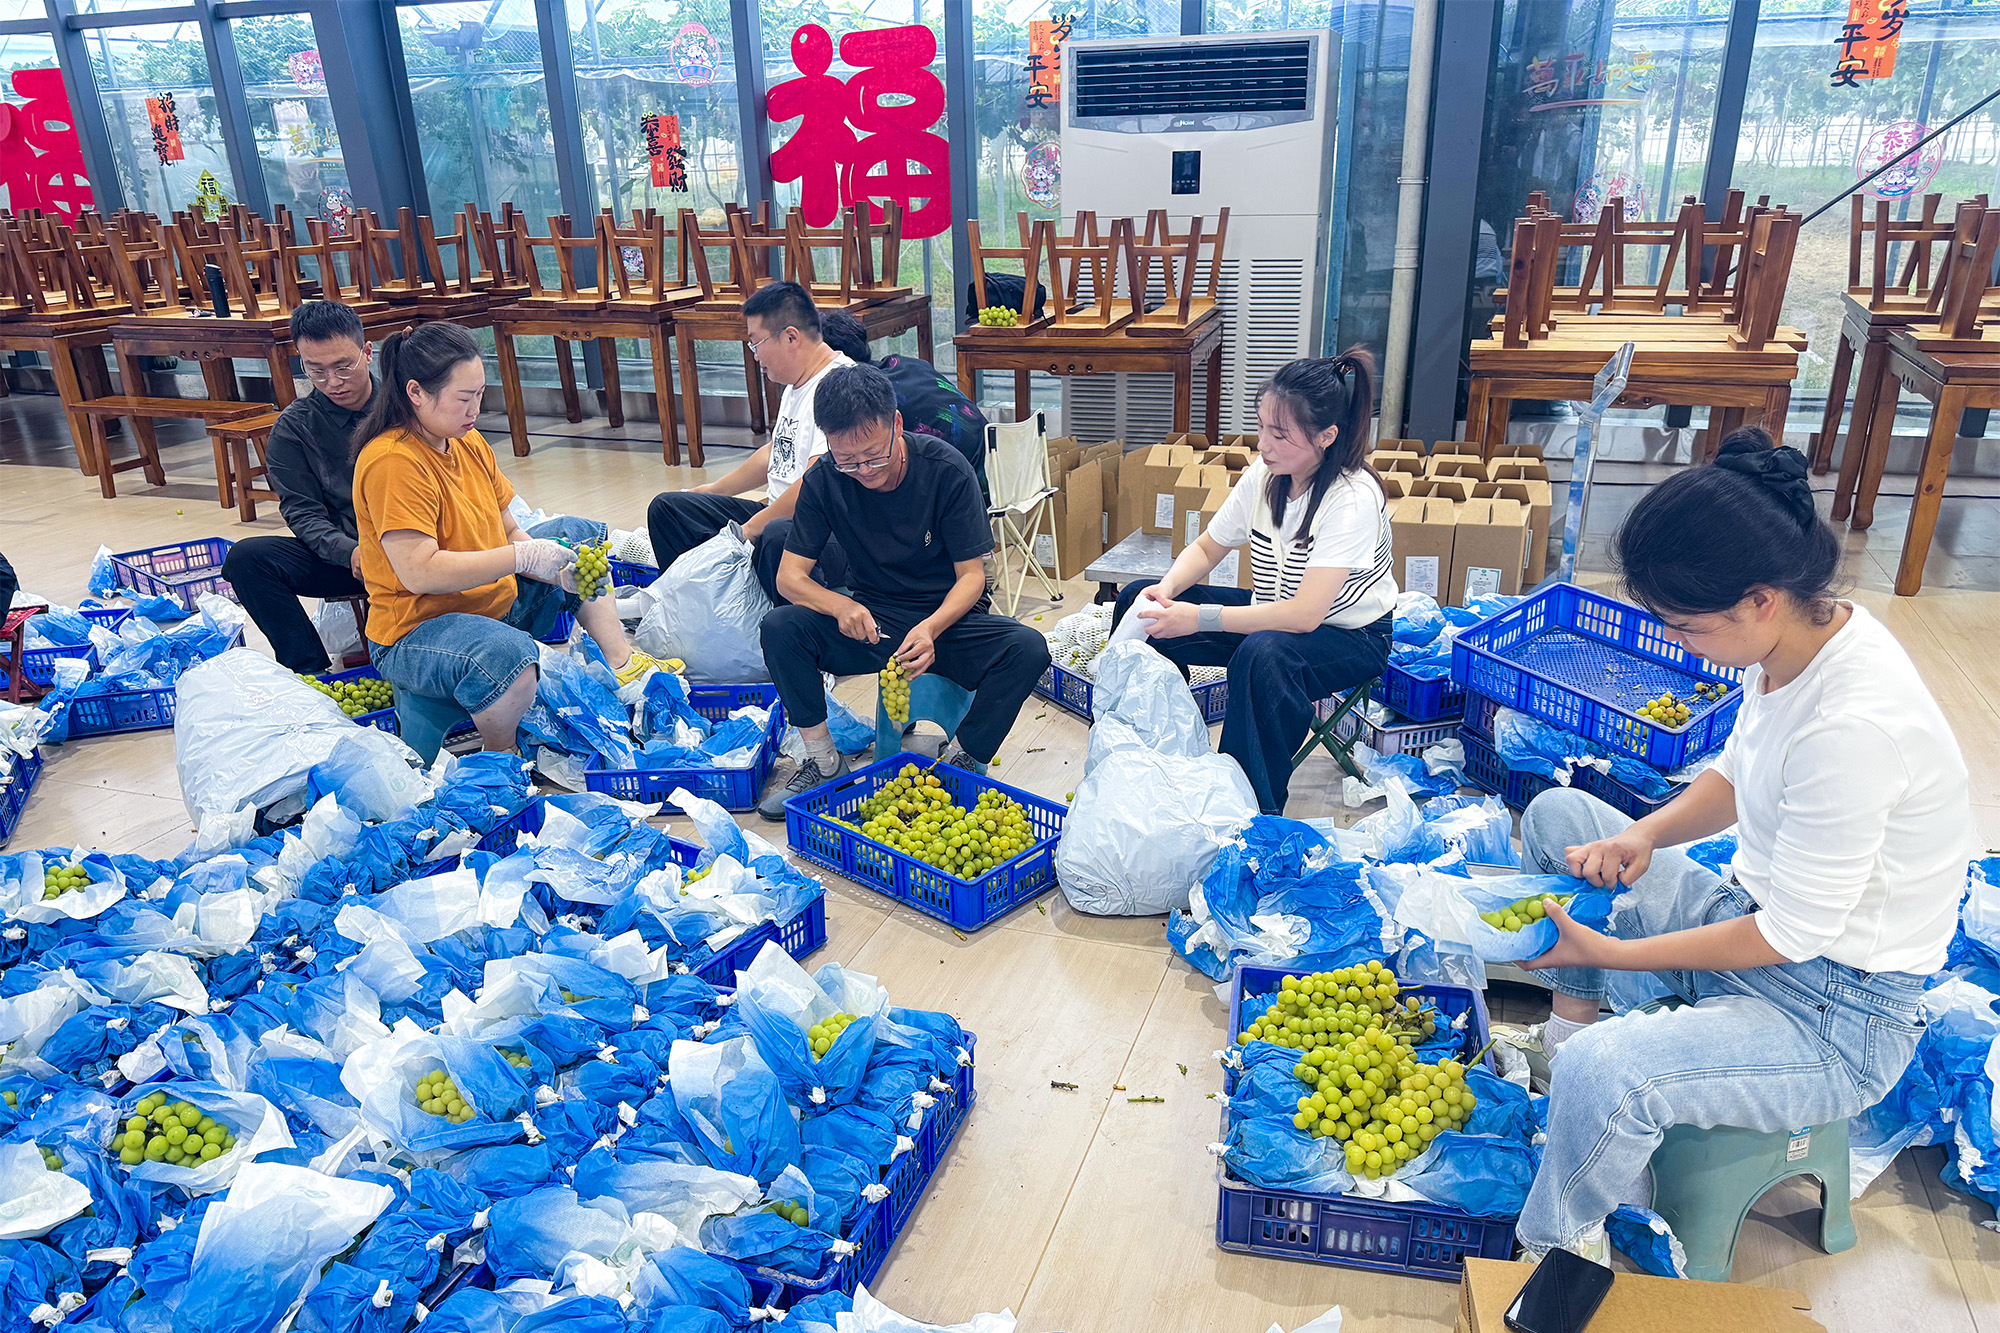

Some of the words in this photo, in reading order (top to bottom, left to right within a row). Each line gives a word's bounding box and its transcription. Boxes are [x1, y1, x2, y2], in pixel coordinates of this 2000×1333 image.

[1023, 55, 1053, 109] 平安
[1830, 24, 1870, 87] 平安
[640, 111, 664, 157] 恭喜
[767, 23, 952, 239] 福
[201, 177, 217, 196] 福
